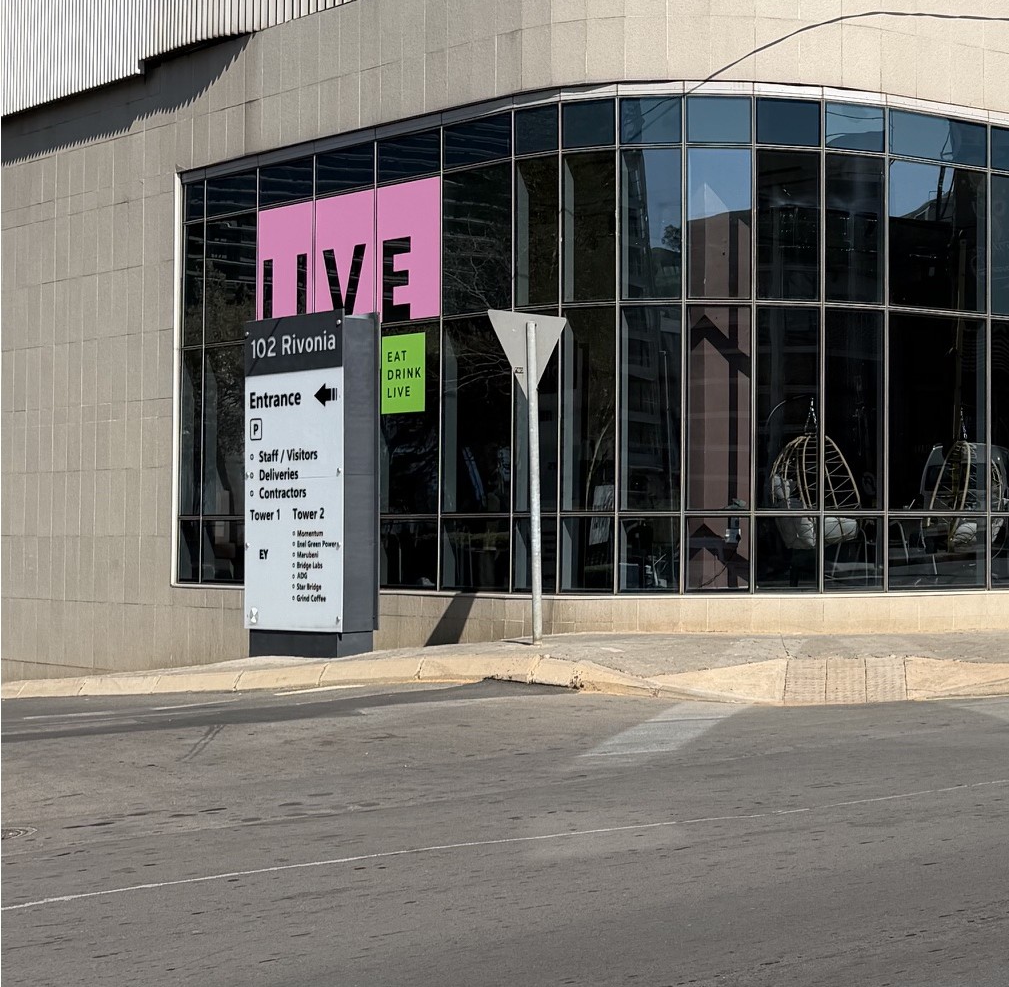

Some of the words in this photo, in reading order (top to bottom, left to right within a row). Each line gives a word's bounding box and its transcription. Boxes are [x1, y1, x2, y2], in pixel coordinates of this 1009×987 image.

[251, 338, 277, 359] 102
[282, 330, 336, 356] Rivonia
[387, 350, 407, 363] EAT
[387, 367, 421, 381] DRINK
[387, 385, 411, 399] LIVE
[250, 390, 302, 411] Entrance
[259, 449, 279, 463] Staff
[286, 448, 318, 461] Visitors
[259, 467, 299, 481] Deliveries
[259, 487, 307, 499] Contractors
[250, 509, 274, 521] Tower
[276, 508, 280, 520] 1
[293, 508, 318, 520] Tower
[319, 507, 325, 519] 2
[308, 540, 321, 548] Green
[259, 549, 269, 560] EY
[297, 562, 311, 571] Bridge
[312, 561, 323, 569] Labs
[307, 583, 322, 592] Bridge
[297, 594, 310, 602] Grind
[310, 594, 326, 603] Coffee
